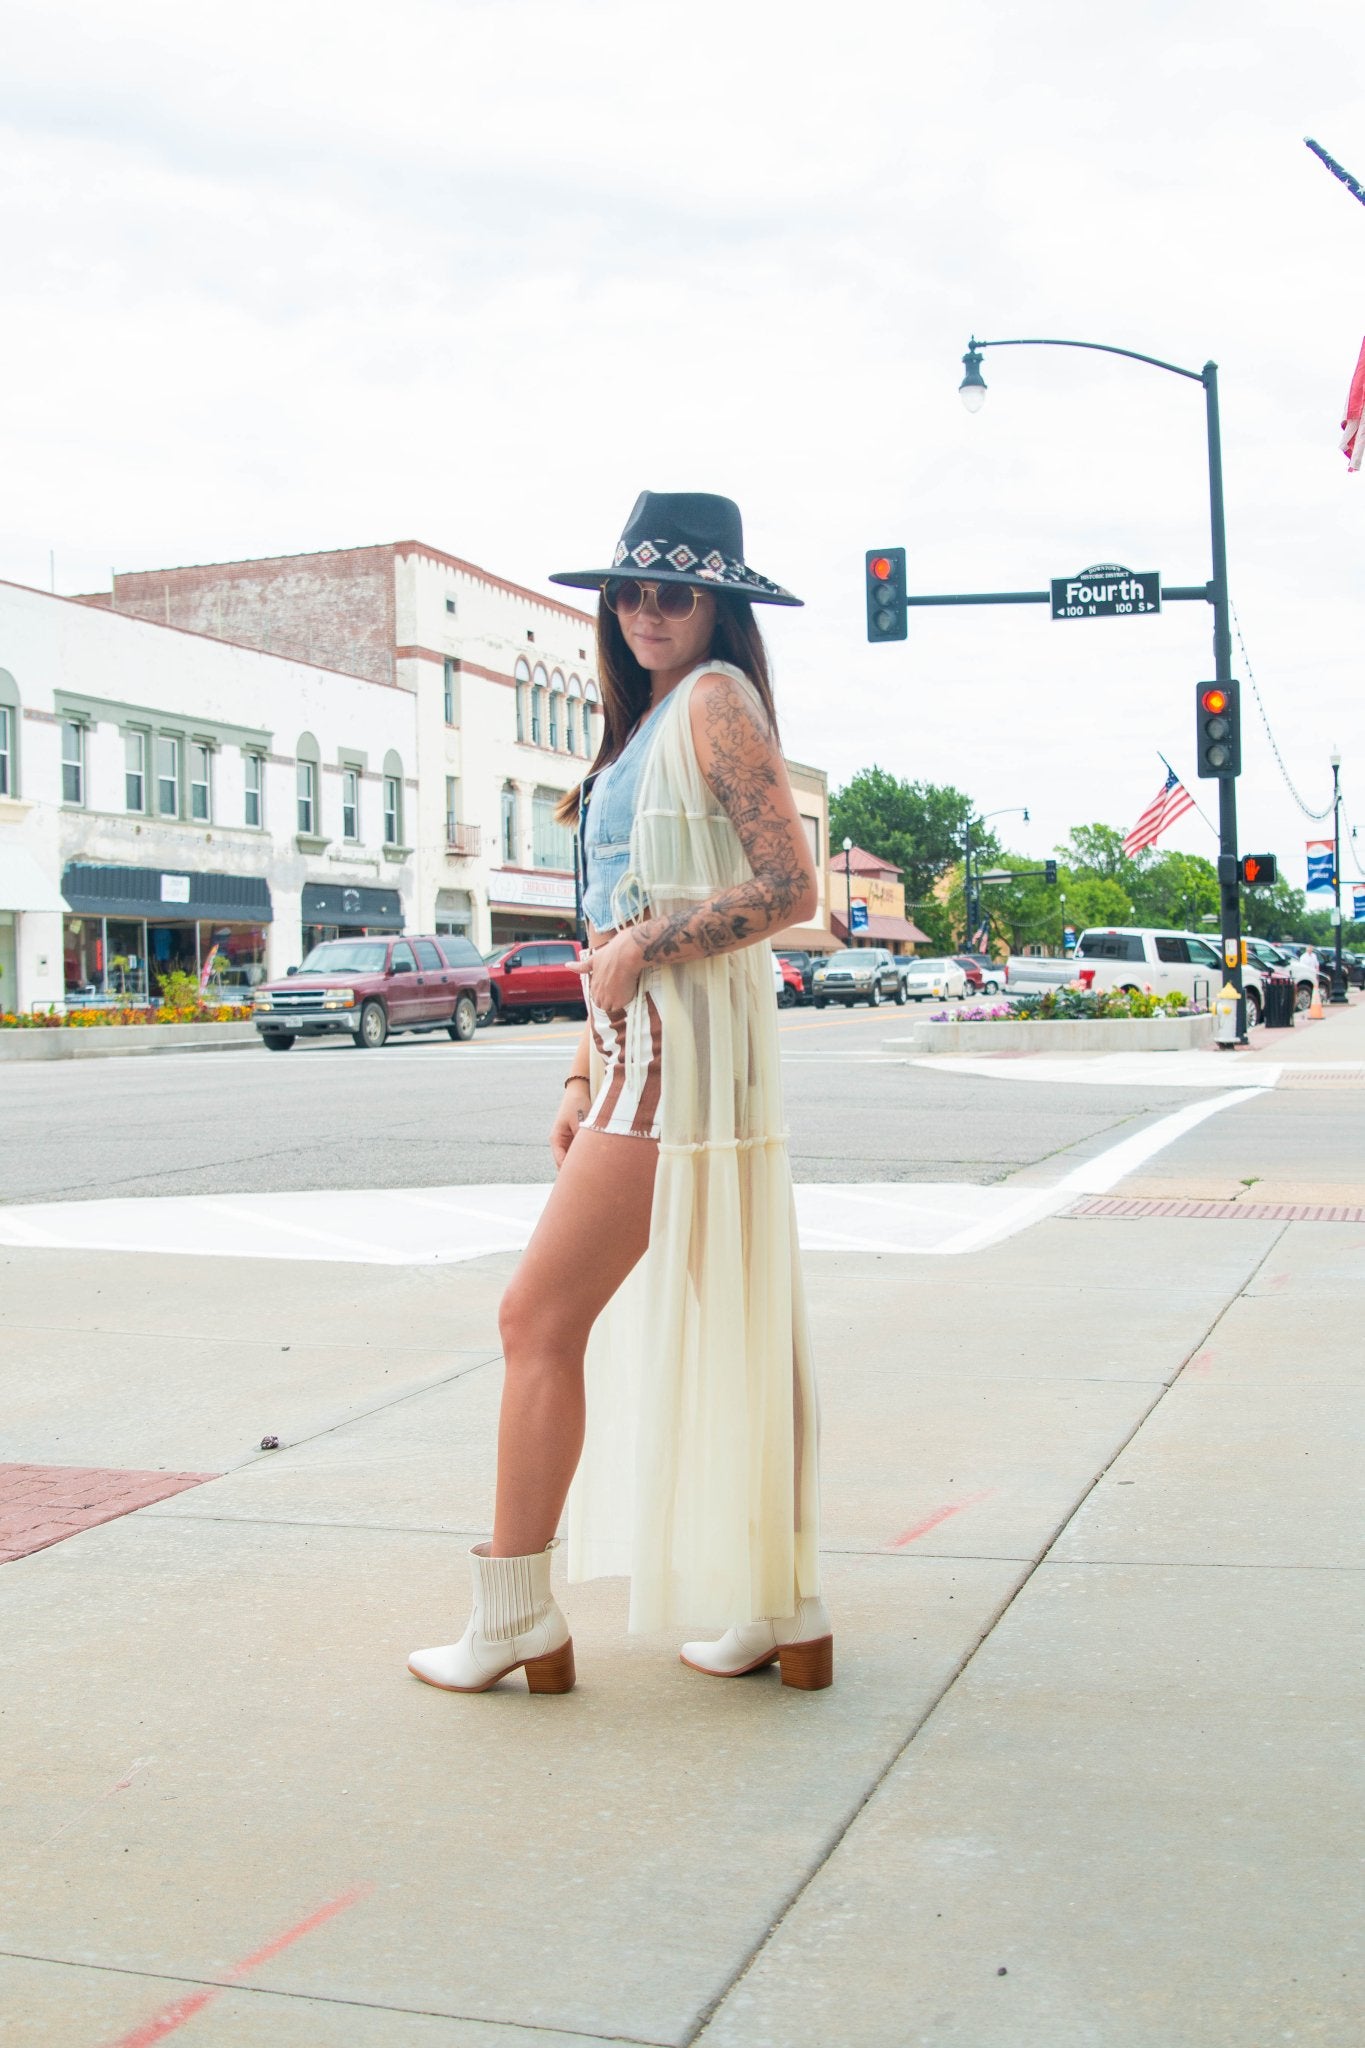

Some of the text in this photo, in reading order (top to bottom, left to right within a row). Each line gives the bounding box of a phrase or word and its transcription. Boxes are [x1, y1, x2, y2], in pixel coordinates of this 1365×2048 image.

[1066, 580, 1144, 604] Fourth
[1066, 605, 1097, 616] 100 N
[1115, 602, 1145, 613] 100 S
